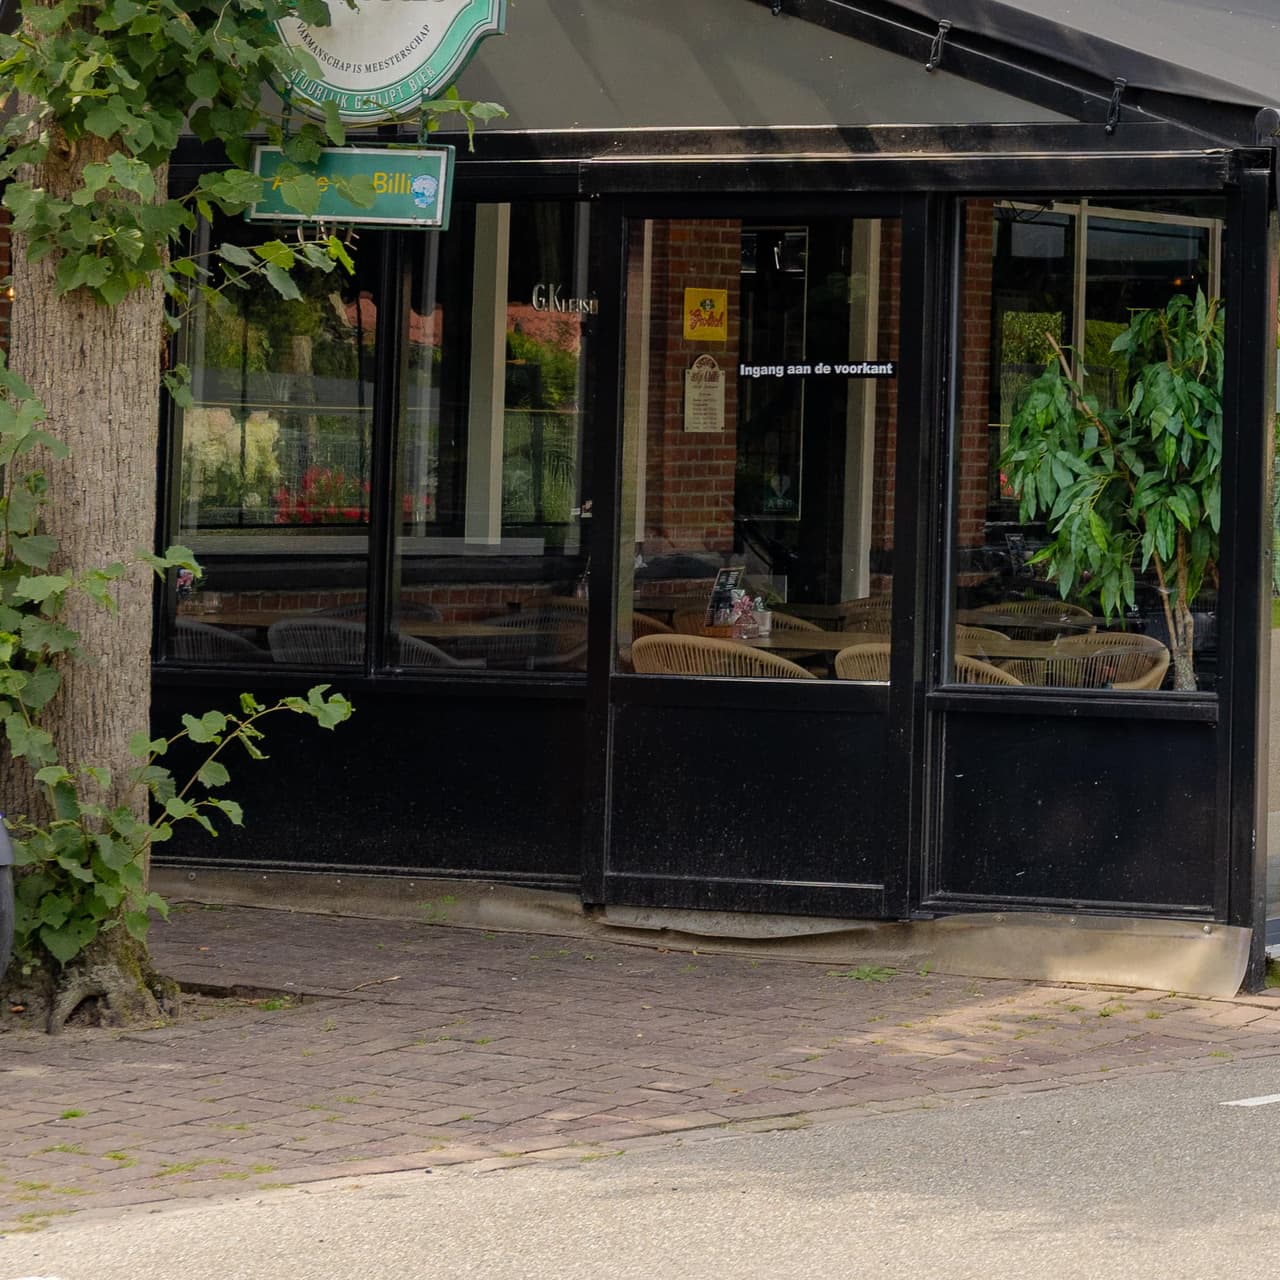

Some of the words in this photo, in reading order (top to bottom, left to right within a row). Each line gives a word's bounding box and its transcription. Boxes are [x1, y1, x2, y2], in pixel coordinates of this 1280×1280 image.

[296, 22, 351, 73] VAKMANSCHAP
[351, 64, 362, 74] IS
[364, 23, 431, 73] MEESTERSCHAP
[409, 66, 436, 94] BIER
[740, 363, 784, 378] Ingang
[787, 365, 811, 375] aan
[814, 363, 831, 374] de
[834, 362, 893, 375] voorkant
